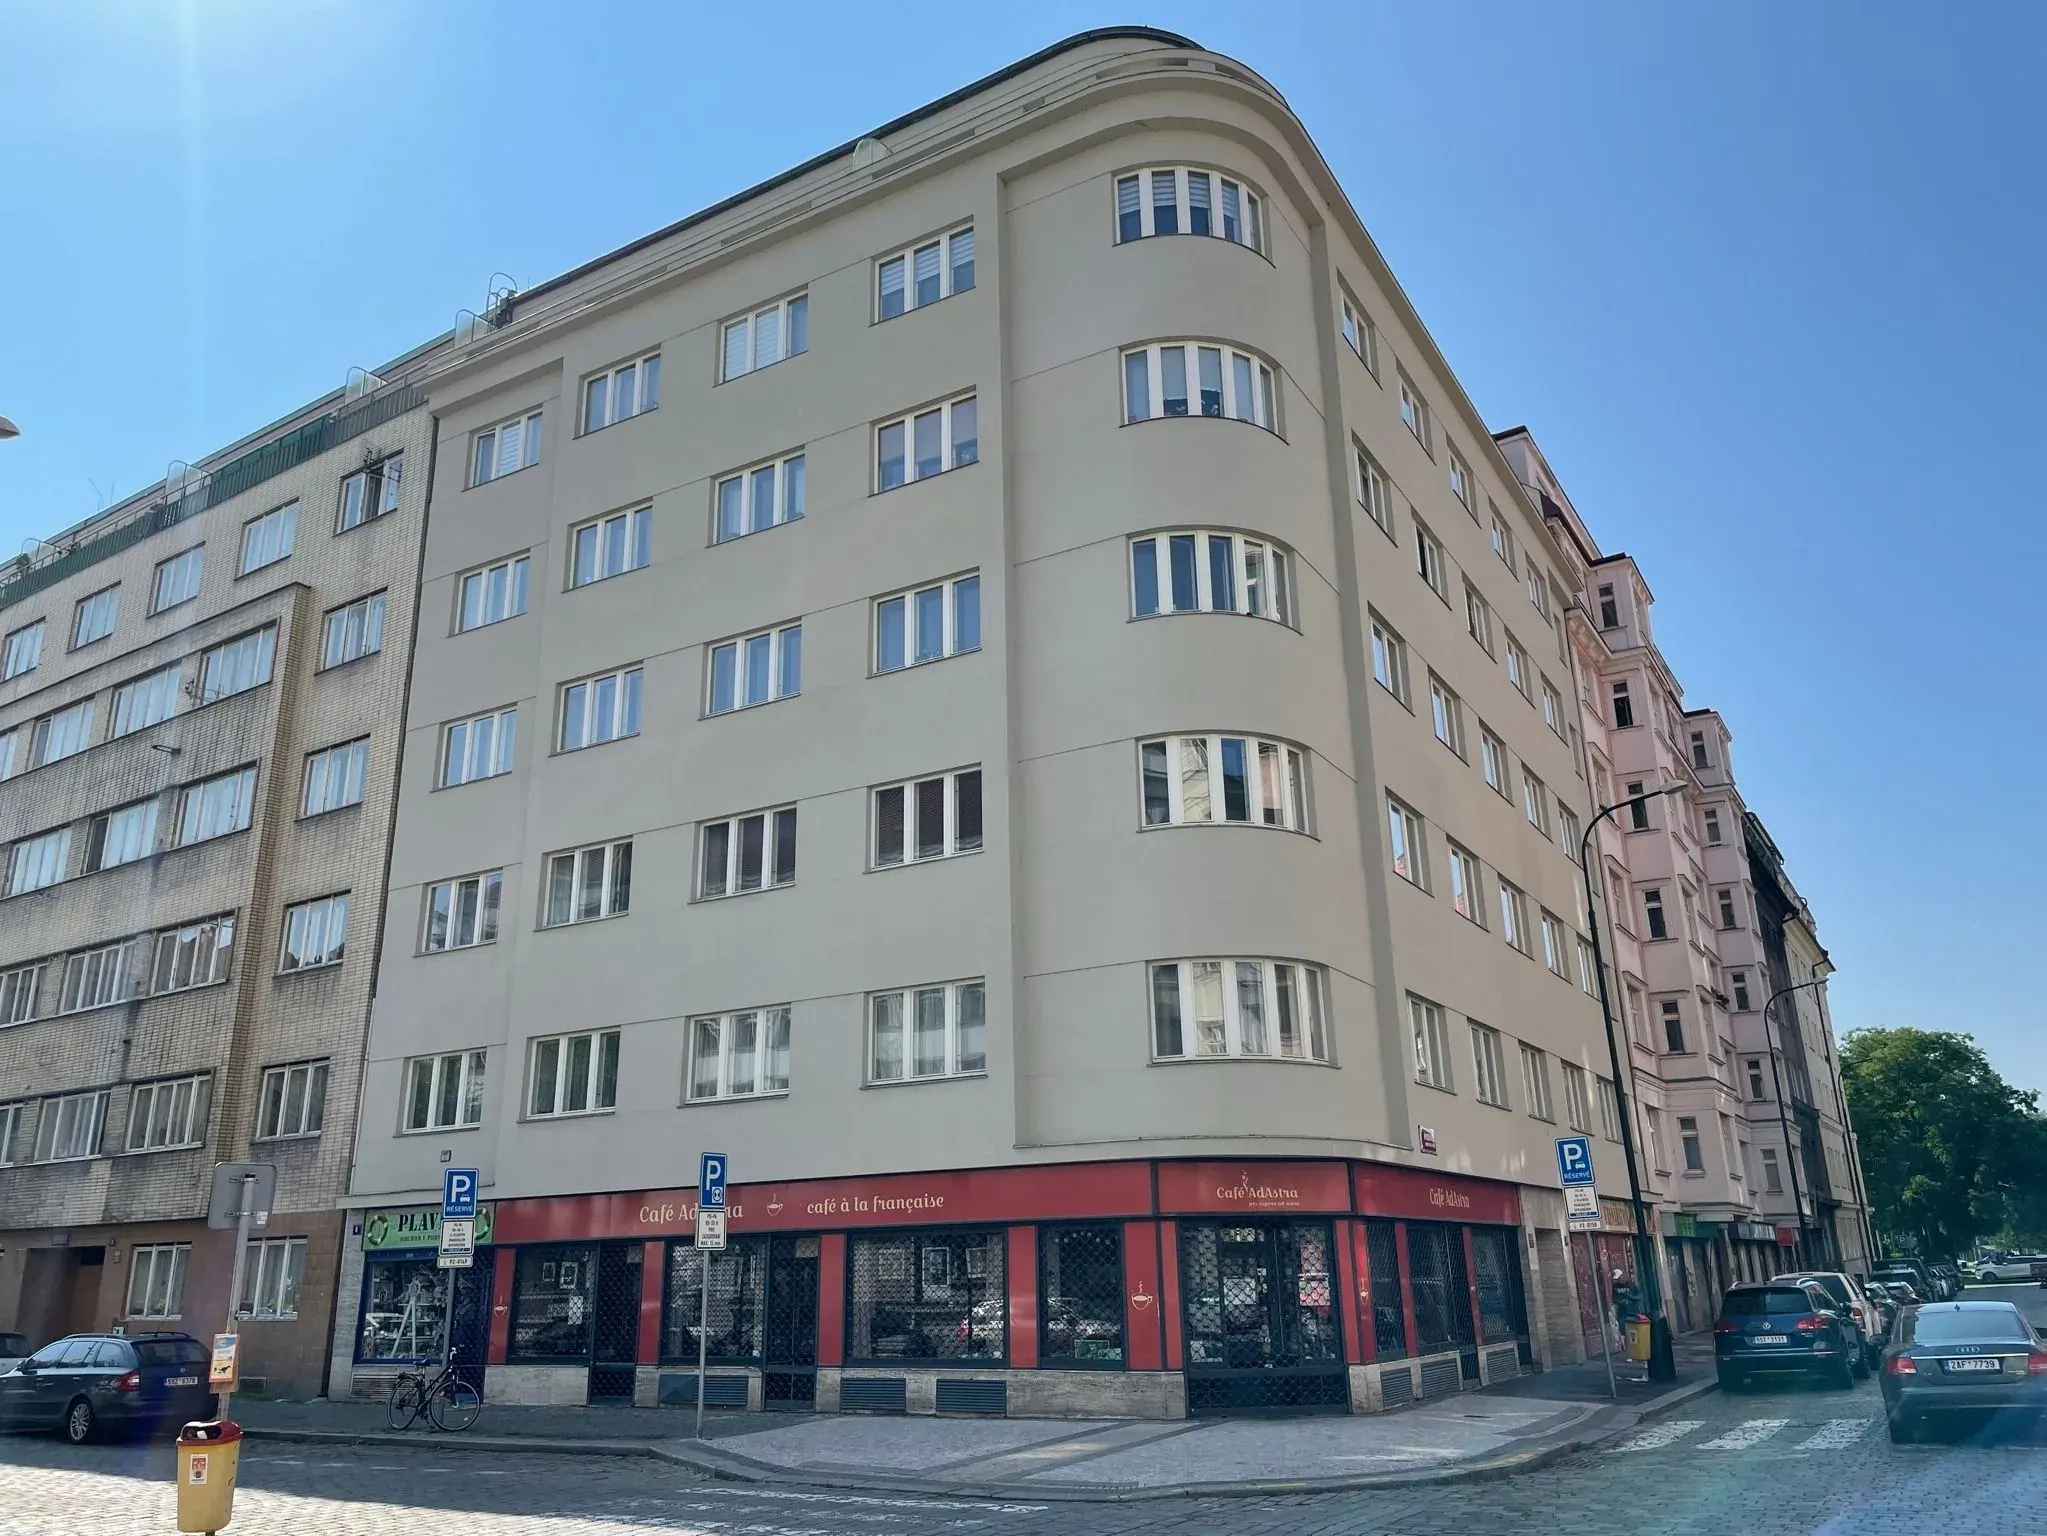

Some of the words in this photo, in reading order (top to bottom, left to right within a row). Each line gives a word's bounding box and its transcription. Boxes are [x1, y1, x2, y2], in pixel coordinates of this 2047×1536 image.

[1563, 1143, 1582, 1171] P
[705, 1160, 722, 1191] P
[450, 1175, 471, 1203] P
[1216, 1186, 1245, 1200] Café
[1248, 1186, 1299, 1198] AdAstra
[1429, 1187, 1444, 1207] Café
[640, 1203, 675, 1224] Café
[807, 1198, 836, 1215] café
[840, 1198, 850, 1213] à
[854, 1196, 869, 1211] la
[873, 1193, 945, 1213] française
[1950, 1361, 1969, 1370] 2AF
[1973, 1360, 1996, 1369] 7739
